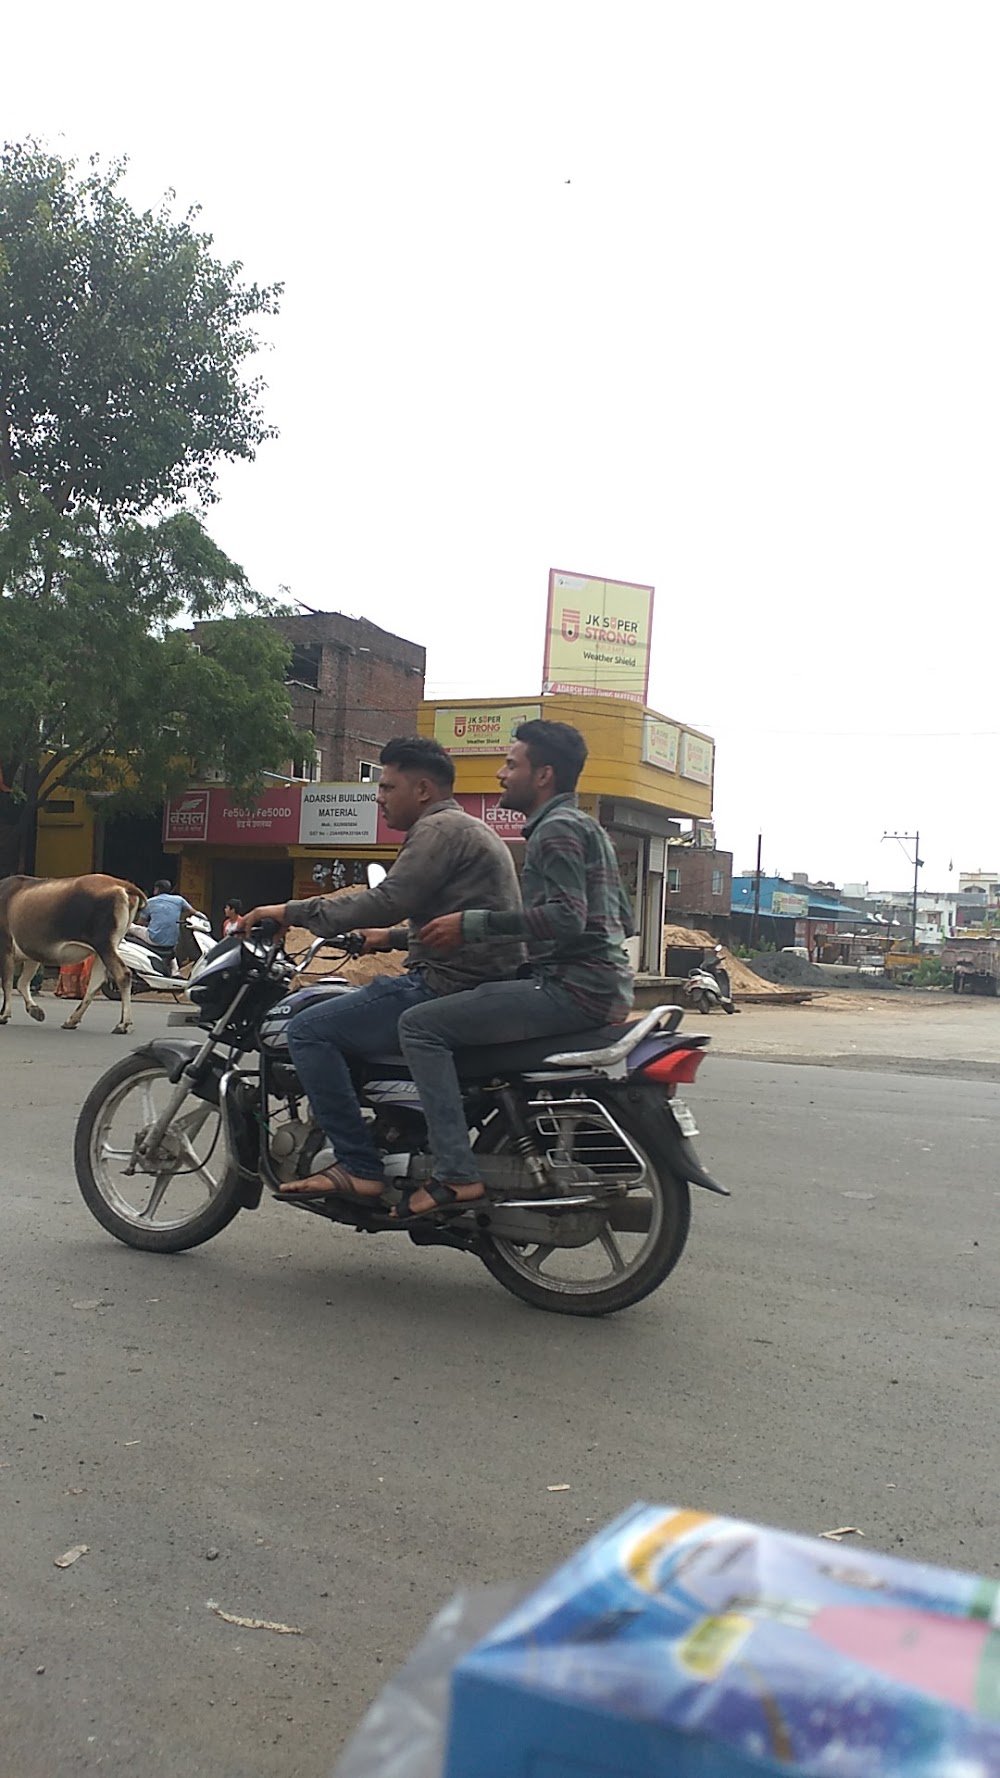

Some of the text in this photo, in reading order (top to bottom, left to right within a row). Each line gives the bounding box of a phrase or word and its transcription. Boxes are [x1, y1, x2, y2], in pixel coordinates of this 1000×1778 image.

[585, 614, 638, 633] JK SUPER
[584, 626, 638, 646] STRONG
[583, 651, 636, 667] Weather Shield
[467, 715, 501, 724] JK SUPER
[467, 723, 501, 733] STRONG
[303, 793, 376, 803] ADARSH BUILDING
[318, 808, 358, 817] MATERIAL
